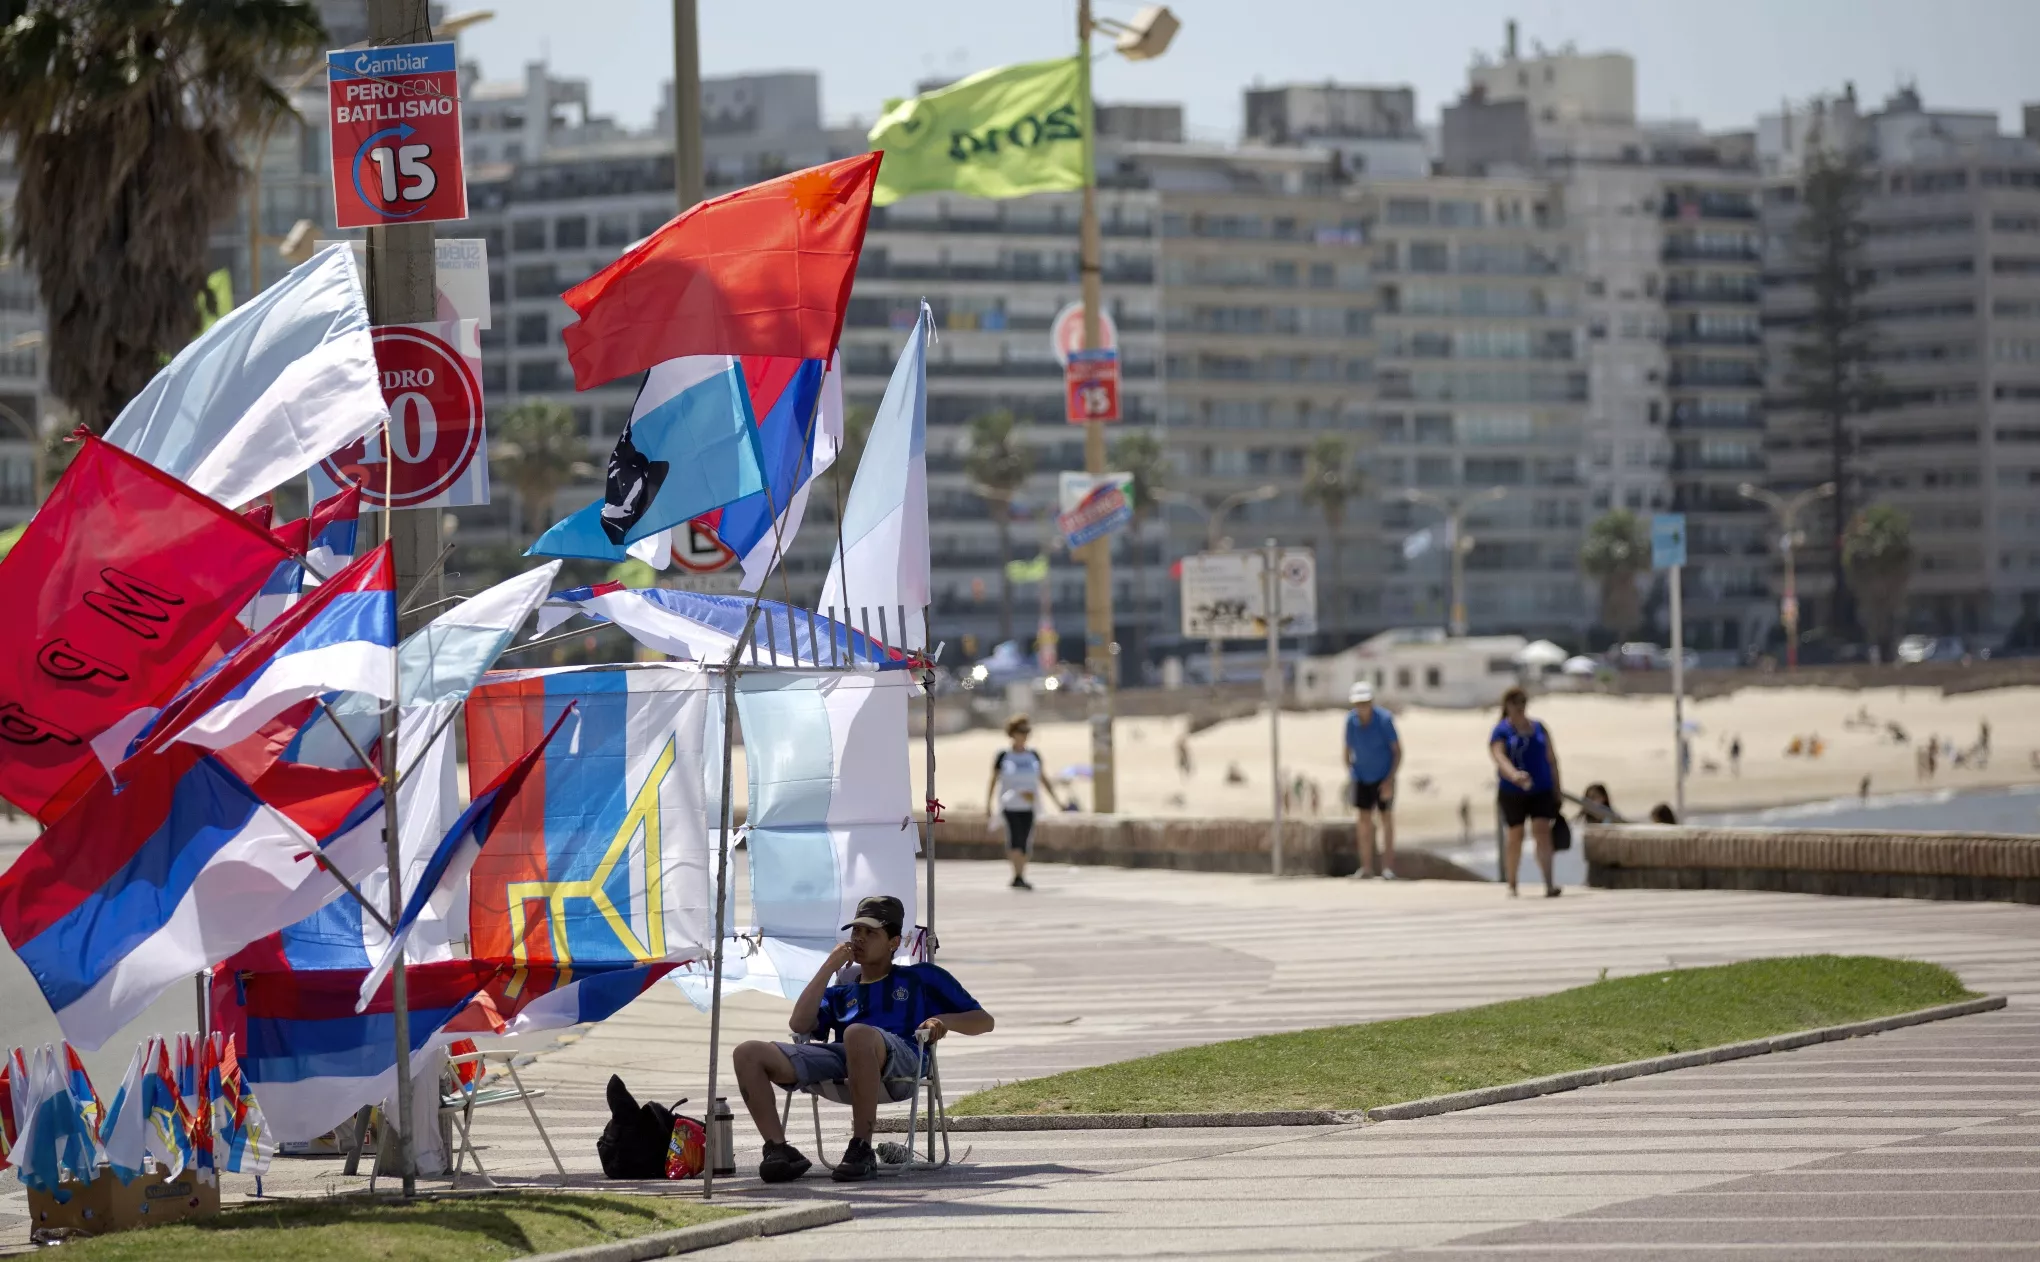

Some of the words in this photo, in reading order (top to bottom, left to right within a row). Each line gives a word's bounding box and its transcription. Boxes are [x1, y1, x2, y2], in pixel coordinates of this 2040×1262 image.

[355, 53, 429, 74] Cambiar
[346, 82, 398, 101] PERO
[402, 78, 441, 97] CON
[336, 98, 453, 124] BATLLISMO
[370, 143, 438, 203] 15
[380, 367, 434, 389] DRO
